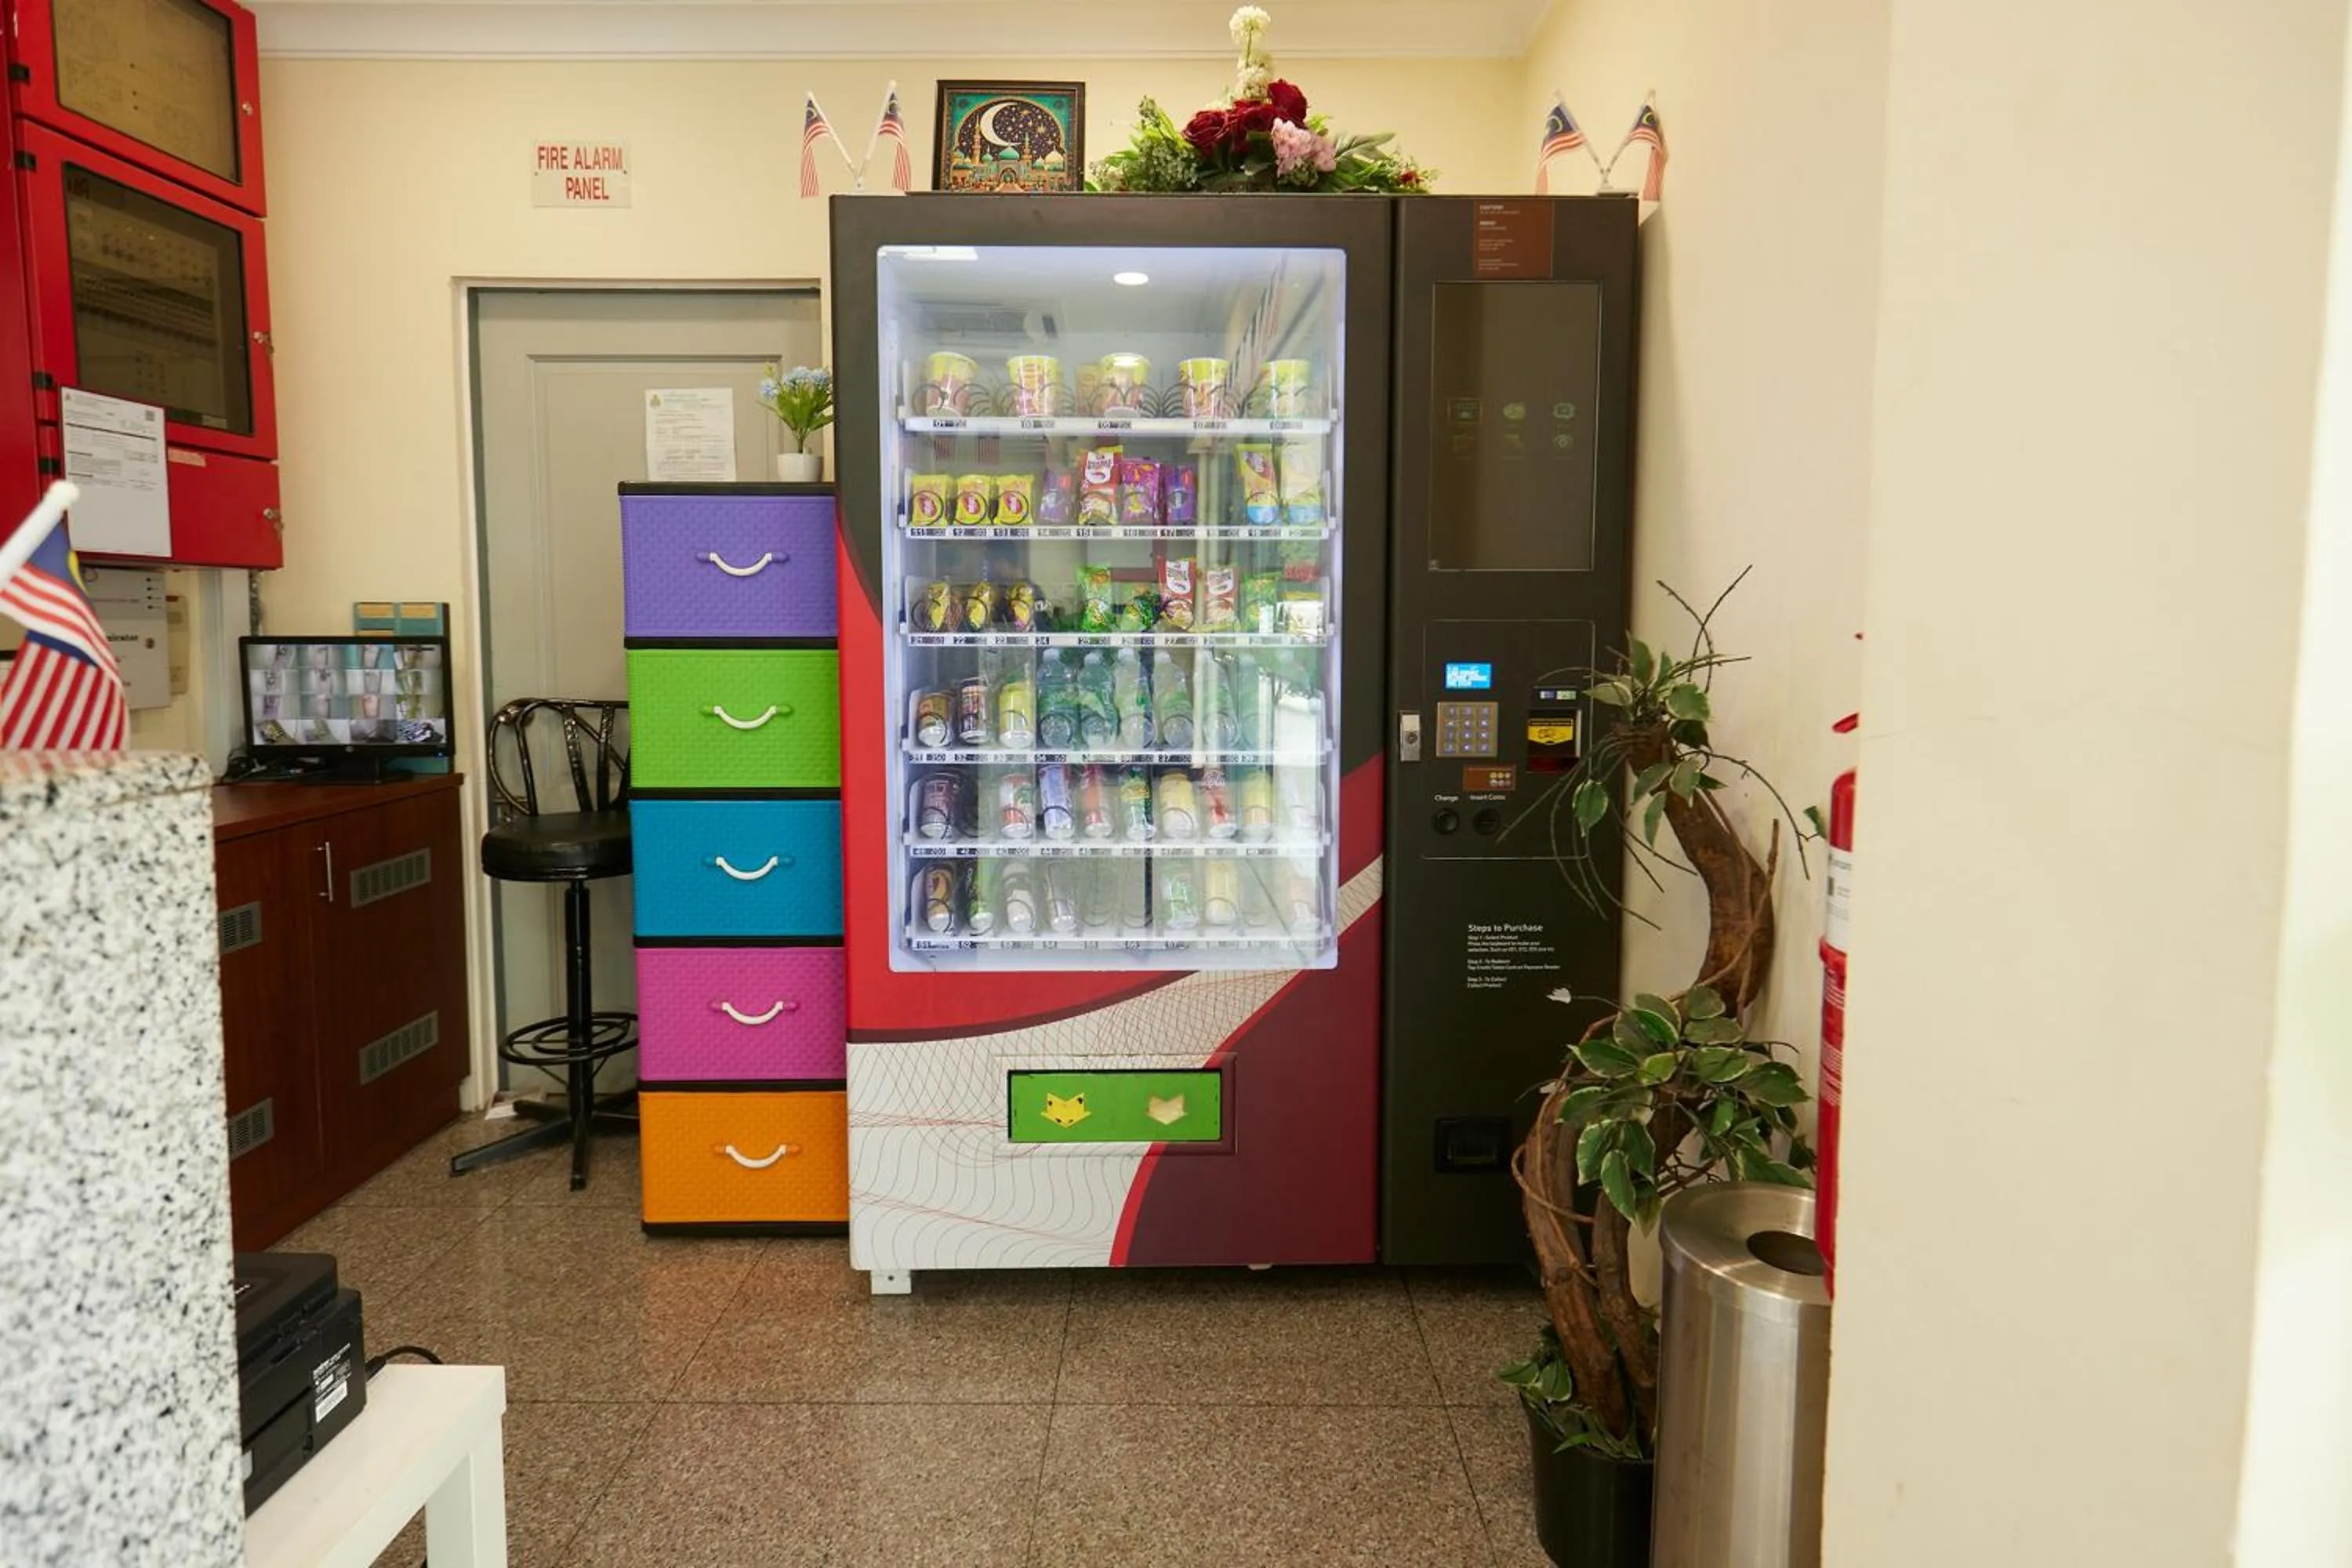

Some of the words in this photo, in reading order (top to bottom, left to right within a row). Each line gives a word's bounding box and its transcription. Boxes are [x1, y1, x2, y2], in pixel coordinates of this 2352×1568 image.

[538, 146, 568, 170] FIRE
[574, 146, 622, 170] ALARM
[565, 176, 610, 200] PANEL
[1434, 794, 1459, 803] Change
[1468, 924, 1492, 934] Steps
[1503, 923, 1544, 932] Purchase
